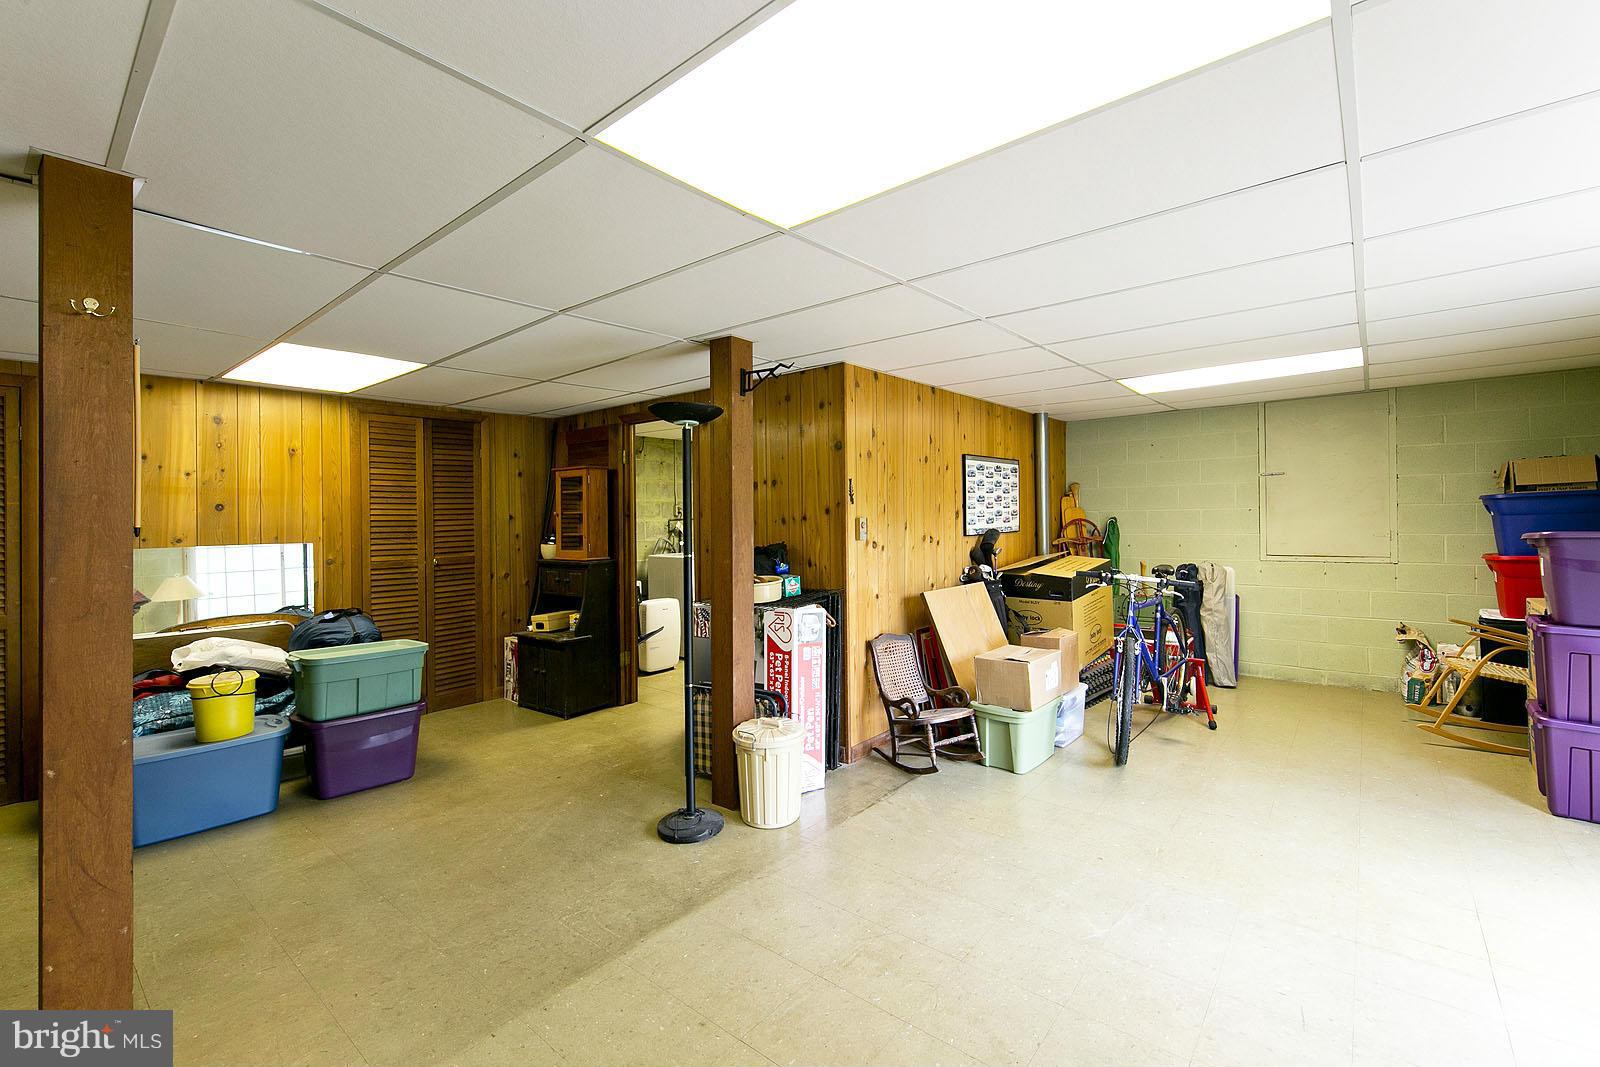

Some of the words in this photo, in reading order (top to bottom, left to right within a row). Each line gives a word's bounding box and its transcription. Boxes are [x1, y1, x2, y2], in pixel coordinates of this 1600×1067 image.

[1014, 578, 1043, 592] Destiny
[774, 611, 785, 632] IRIS
[775, 653, 783, 672] Pet
